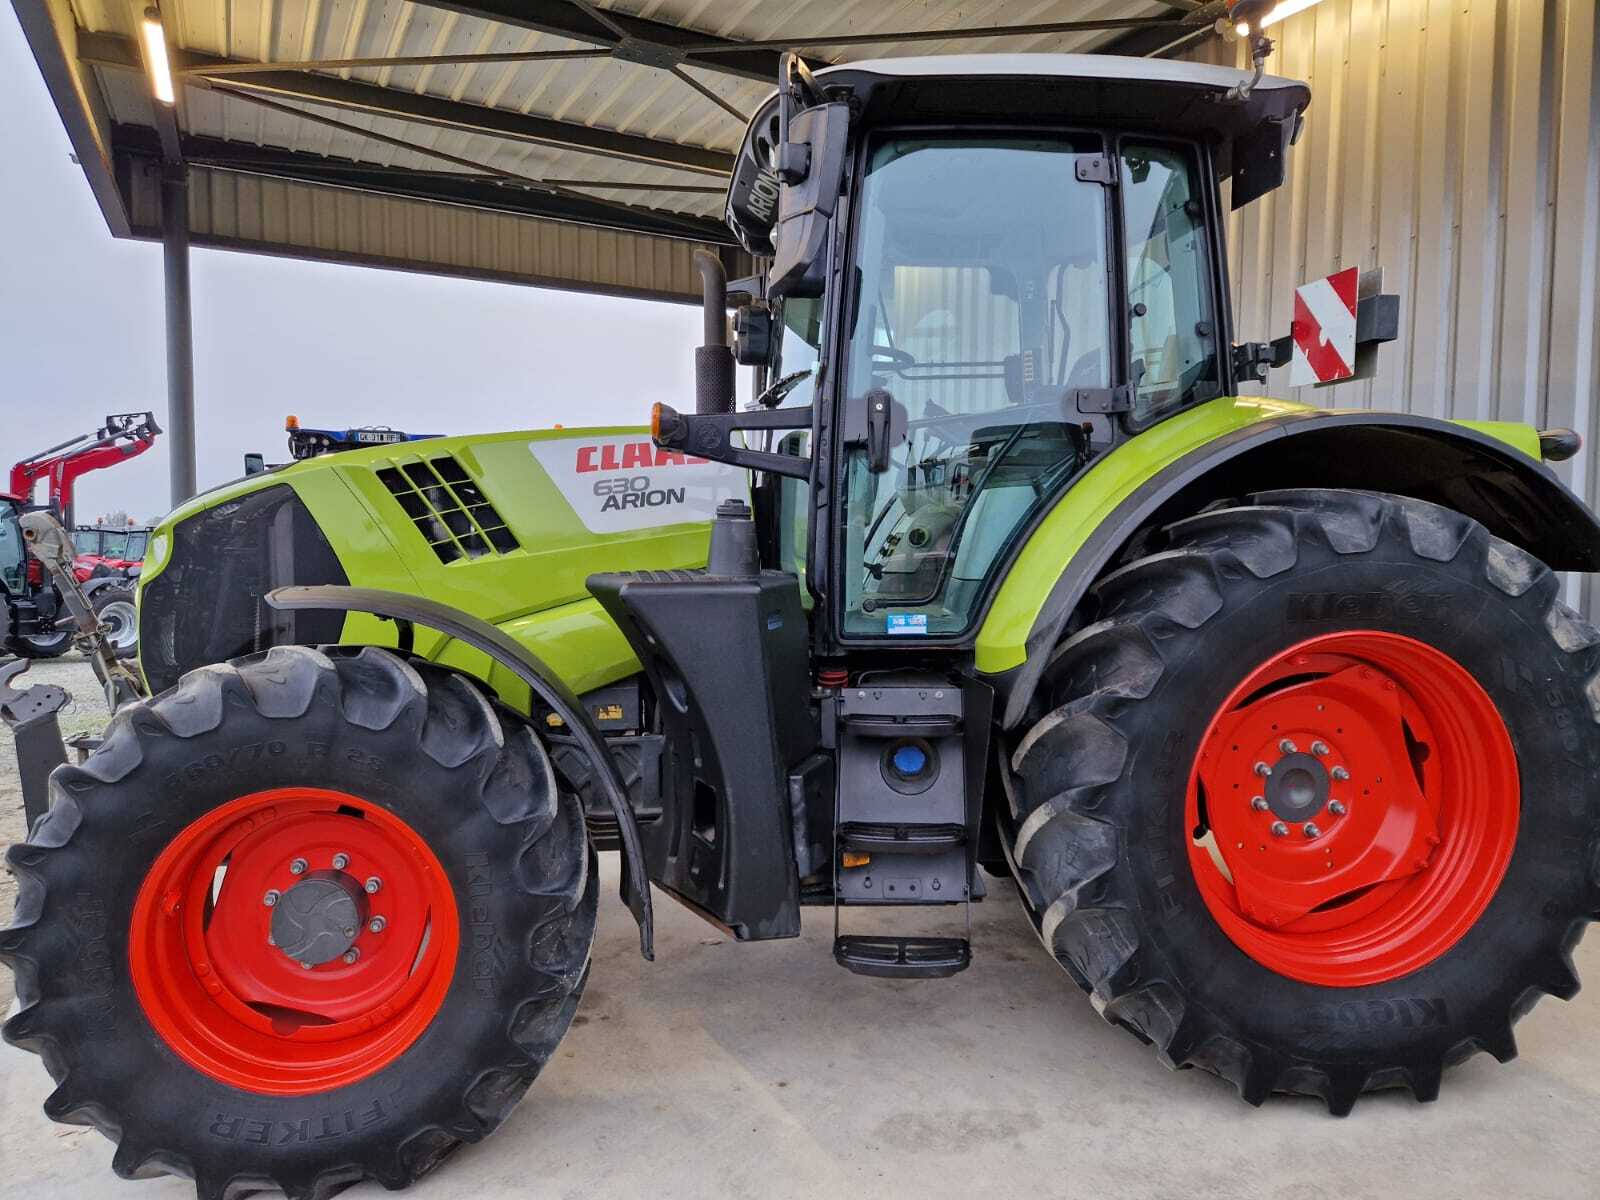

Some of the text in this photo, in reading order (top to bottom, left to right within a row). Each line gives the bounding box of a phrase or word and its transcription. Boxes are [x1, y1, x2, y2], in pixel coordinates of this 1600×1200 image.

[746, 167, 780, 222] ARION
[576, 442, 711, 474] CLAA
[593, 475, 650, 497] 630
[601, 487, 685, 512] ARION
[208, 1097, 392, 1146] FITKER
